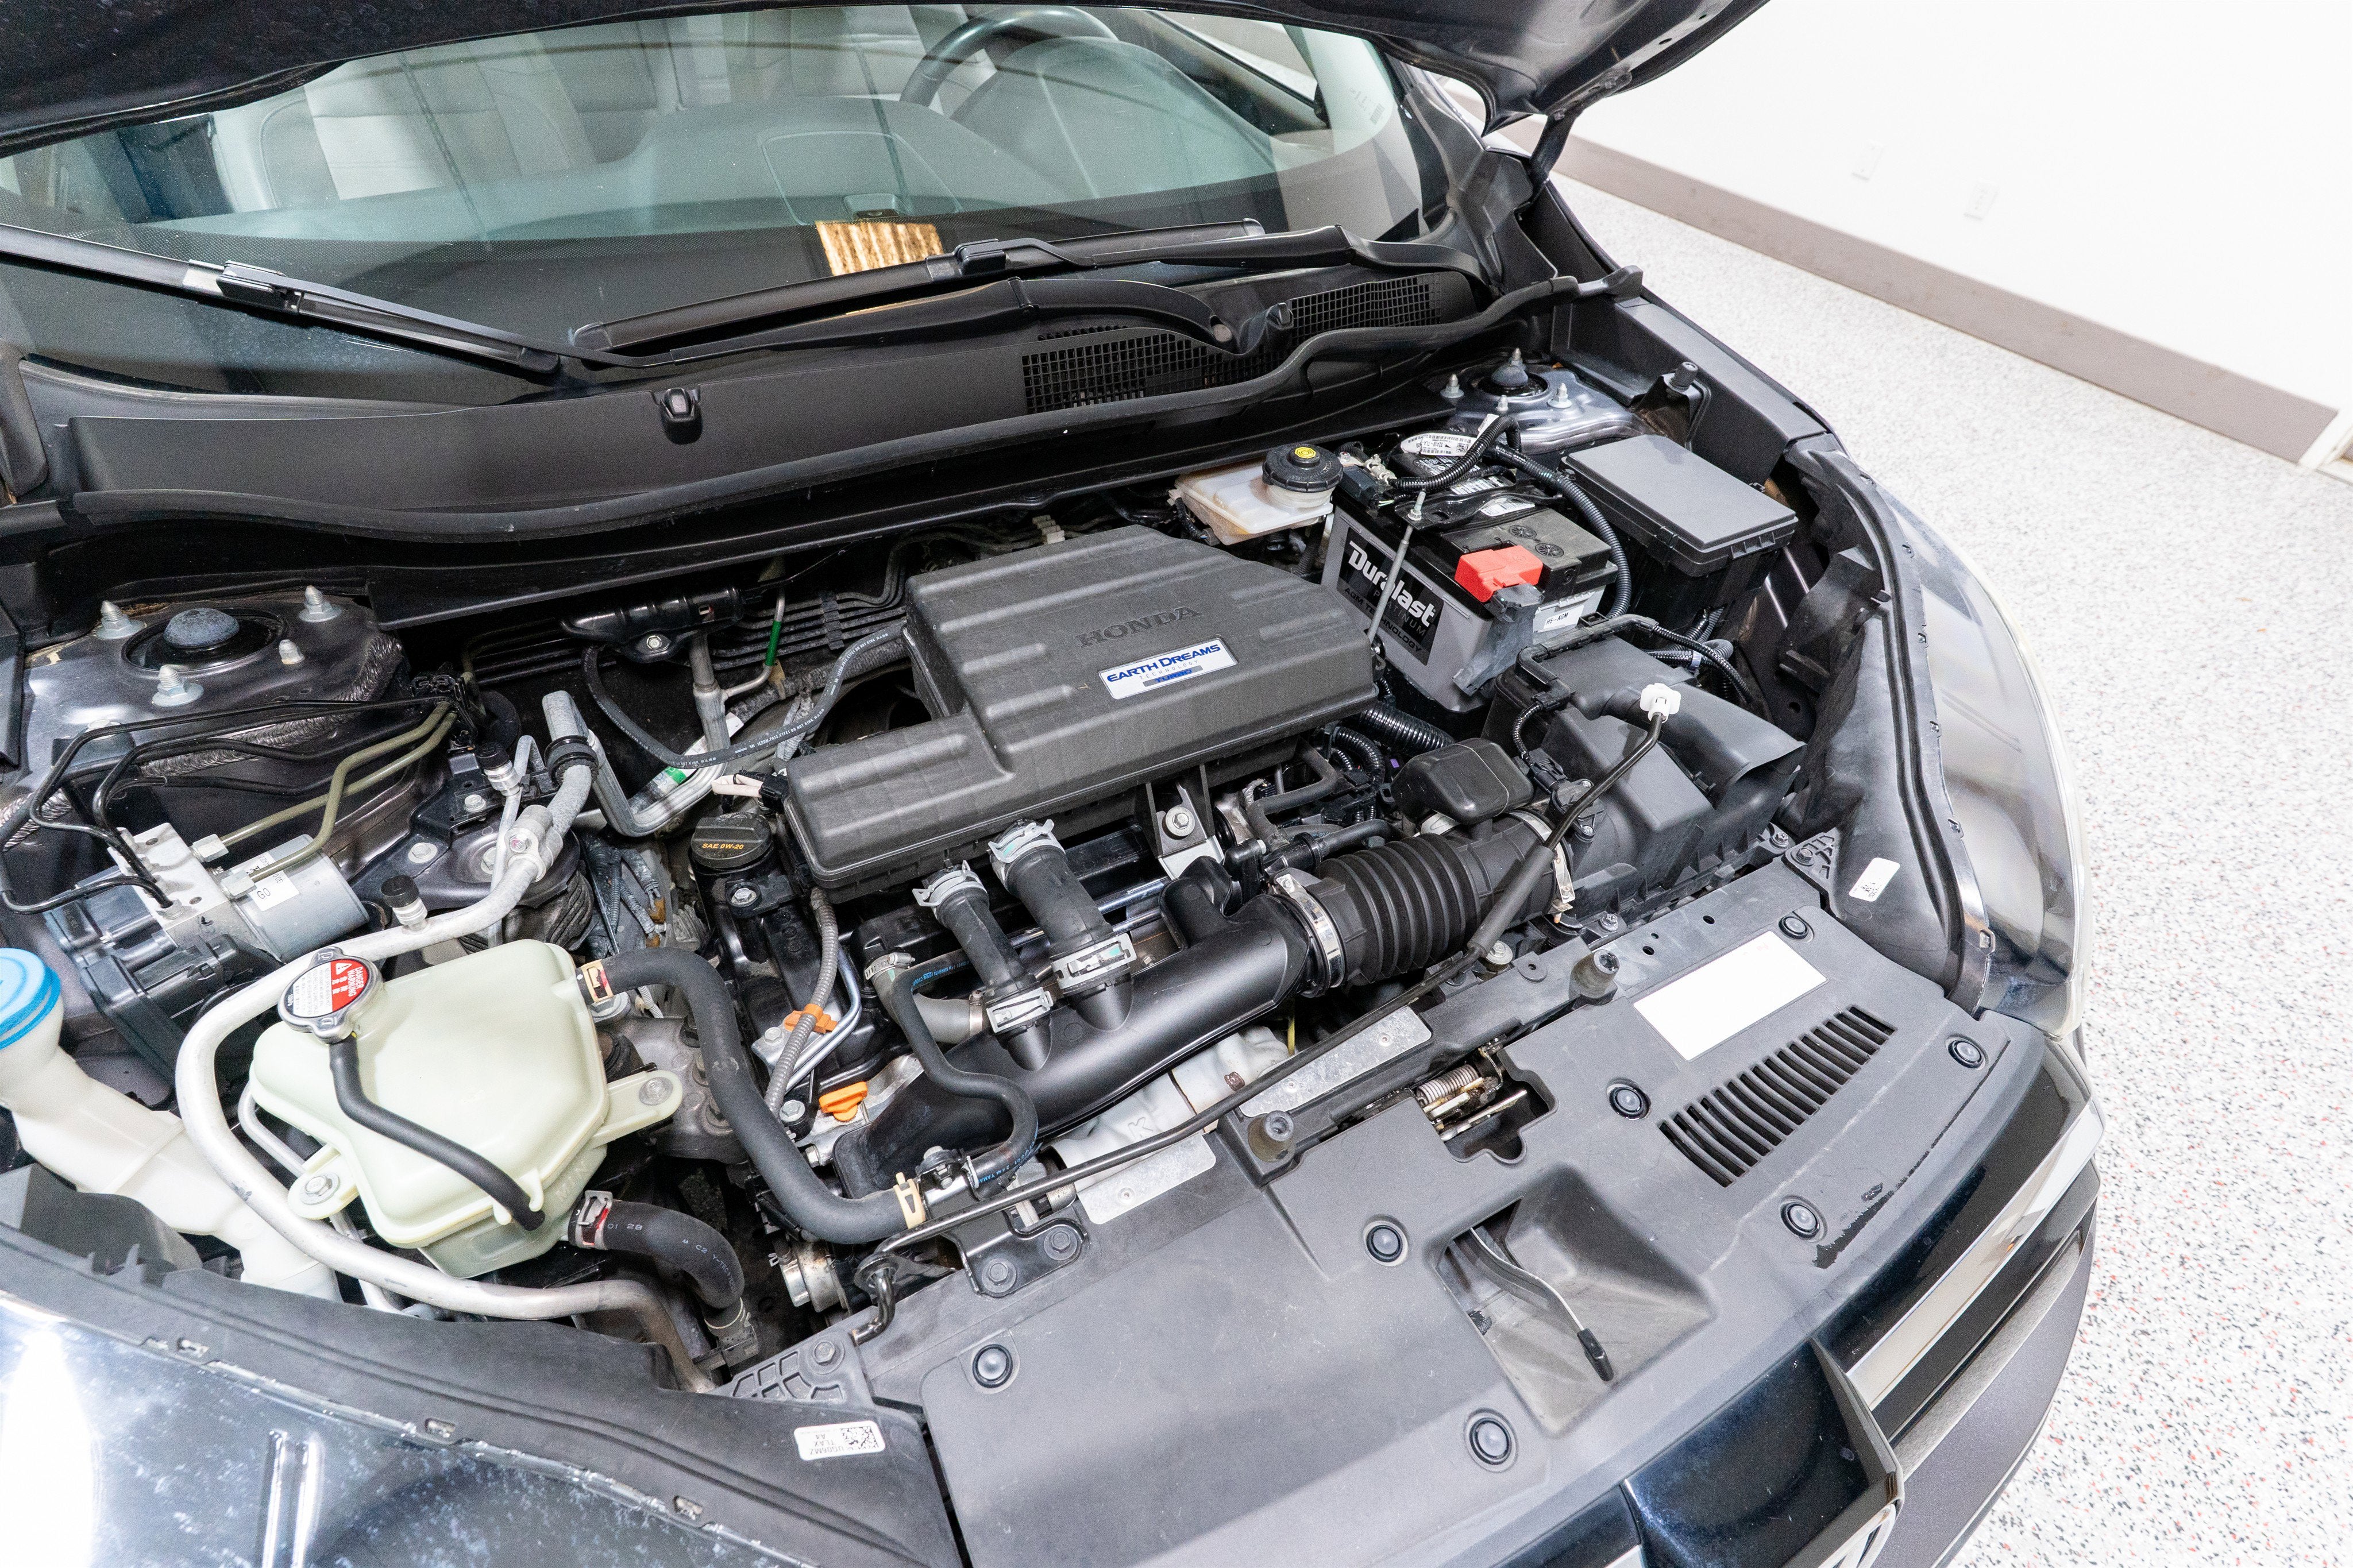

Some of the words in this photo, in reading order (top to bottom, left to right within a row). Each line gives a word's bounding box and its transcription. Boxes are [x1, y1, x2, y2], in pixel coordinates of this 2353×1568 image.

[1075, 607, 1202, 648] HONDA
[1345, 587, 1363, 605] AGM
[1365, 603, 1422, 652] TEHNOLOGY
[1373, 588, 1426, 636] PATINUM
[1106, 663, 1158, 682] EARTH
[1159, 644, 1221, 667] DREAMS
[1139, 659, 1199, 680] TECHNOLOGY
[1154, 669, 1193, 683] TURBO
[347, 969, 357, 997] WARNUNG
[355, 966, 364, 990] DANGER
